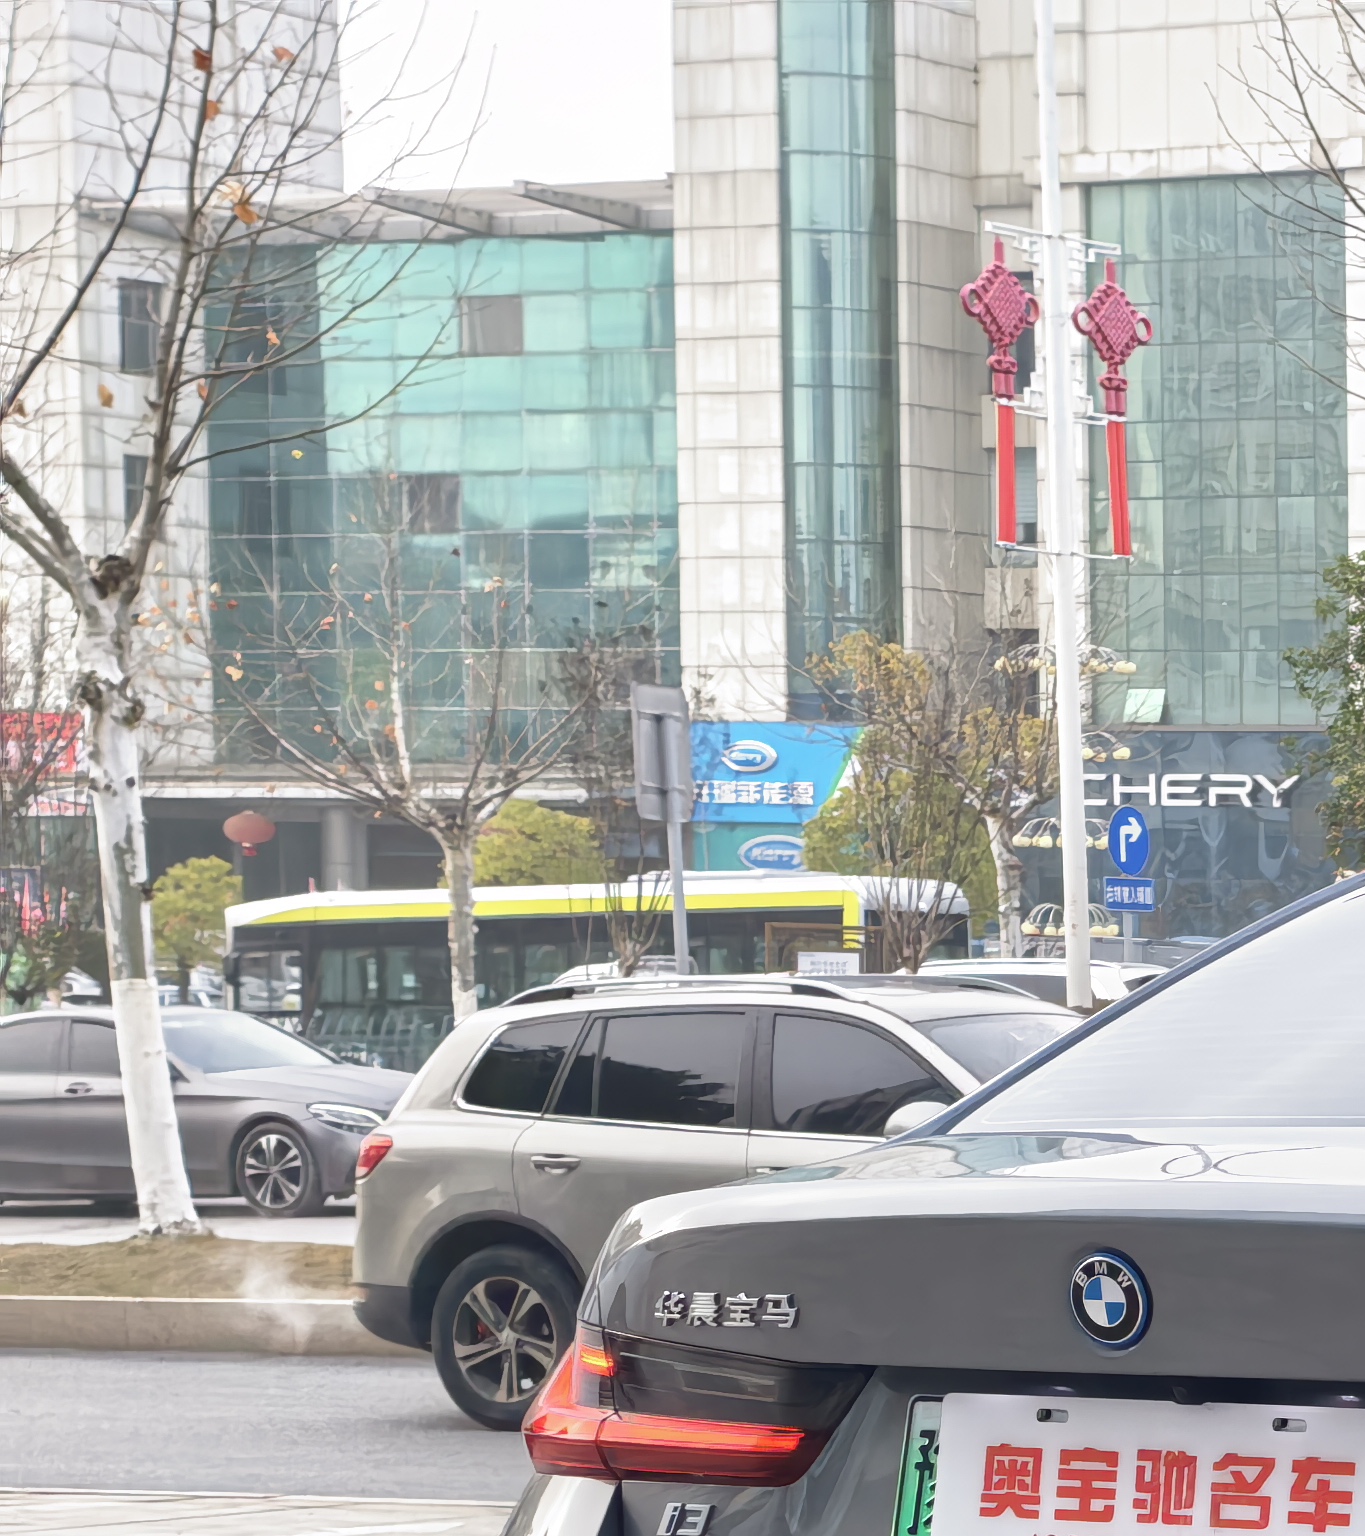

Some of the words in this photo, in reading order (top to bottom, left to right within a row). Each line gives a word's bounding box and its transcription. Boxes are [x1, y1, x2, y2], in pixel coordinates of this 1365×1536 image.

[1075, 1261, 1132, 1288] BMW
[654, 1291, 798, 1328] 华晨宝马
[978, 1443, 1357, 1533] 奥宝驰名车
[656, 1502, 711, 1536] i3
